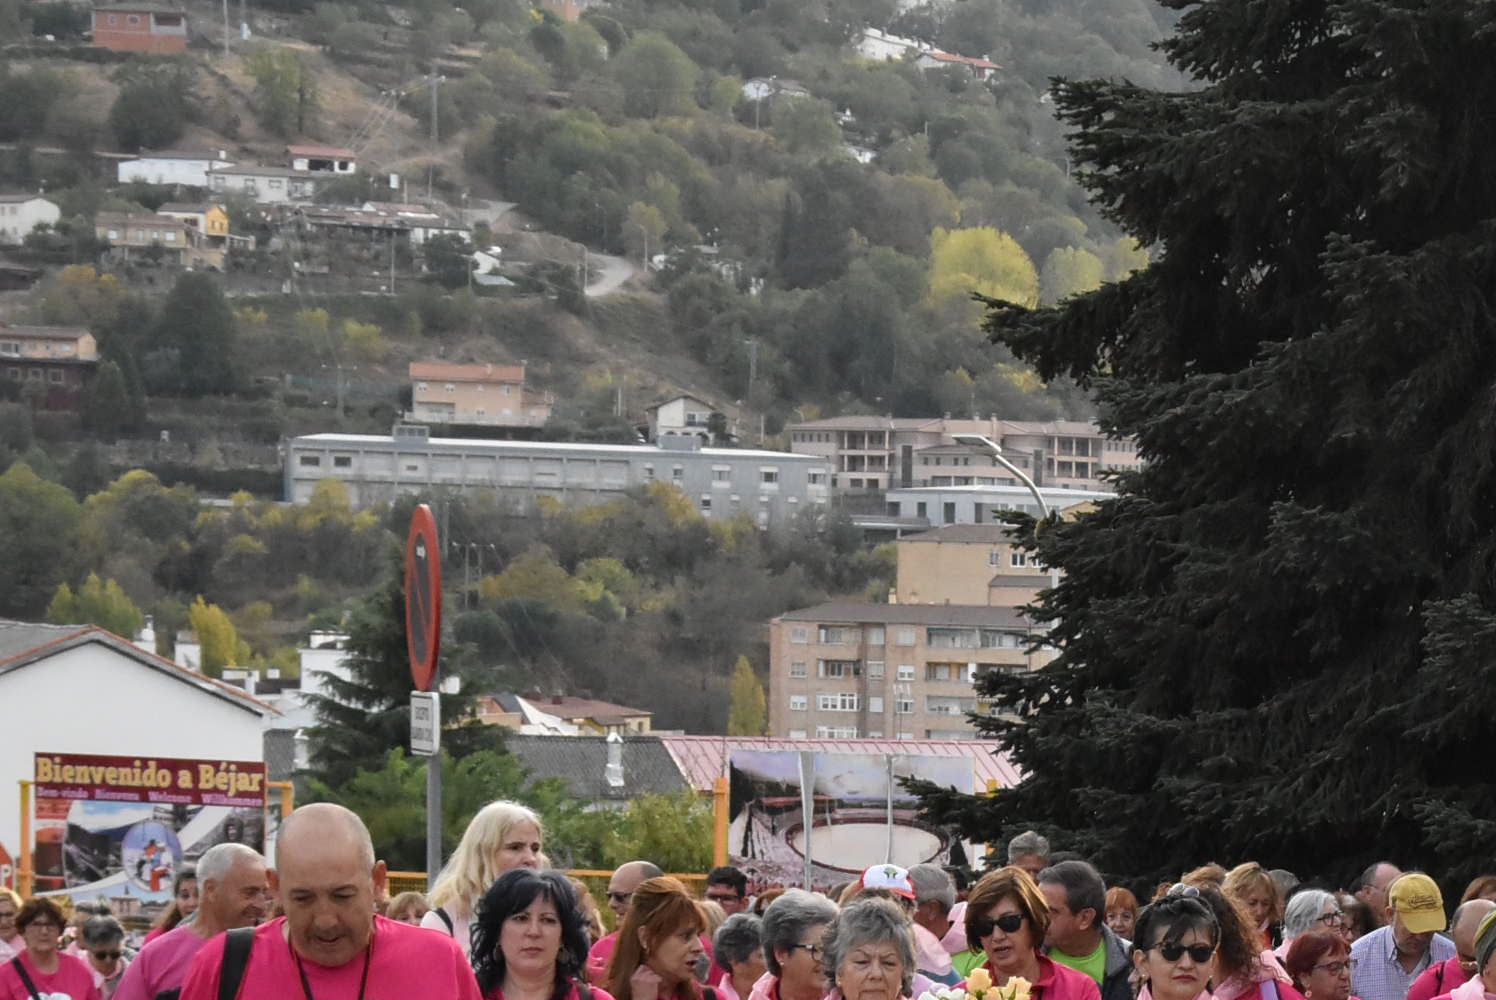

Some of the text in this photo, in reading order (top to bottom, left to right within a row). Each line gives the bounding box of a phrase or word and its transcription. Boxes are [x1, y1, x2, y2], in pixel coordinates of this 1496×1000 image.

[36, 757, 263, 797] Bienvenido a Béjar
